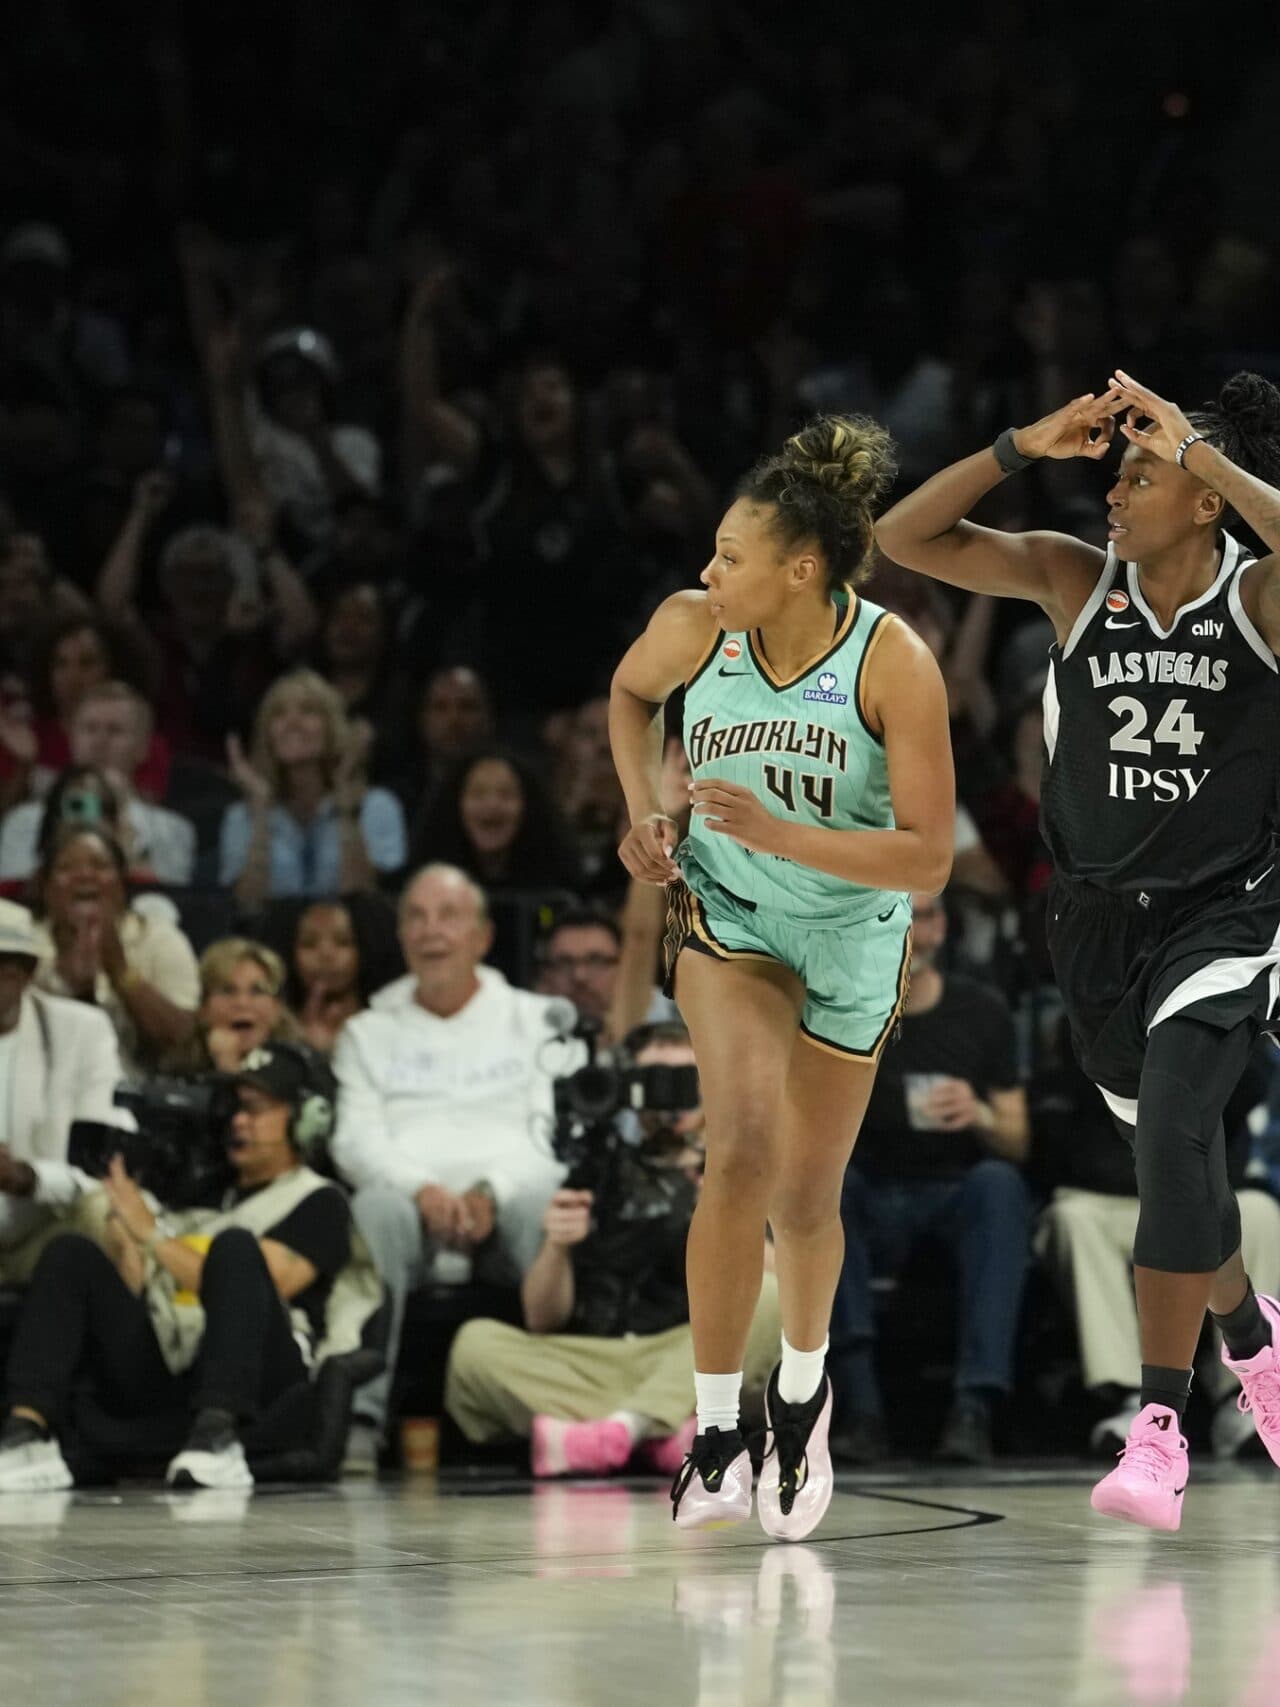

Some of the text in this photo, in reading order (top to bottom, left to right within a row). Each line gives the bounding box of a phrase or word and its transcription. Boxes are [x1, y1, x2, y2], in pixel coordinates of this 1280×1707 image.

[1191, 619, 1224, 640] ally
[1088, 650, 1229, 691] LAS VEGAS
[804, 690, 846, 704] BARCLAYS
[689, 713, 848, 775] BROOKLYN
[1107, 695, 1205, 756] 24
[763, 763, 834, 818] 44
[1108, 762, 1211, 802] IPSY
